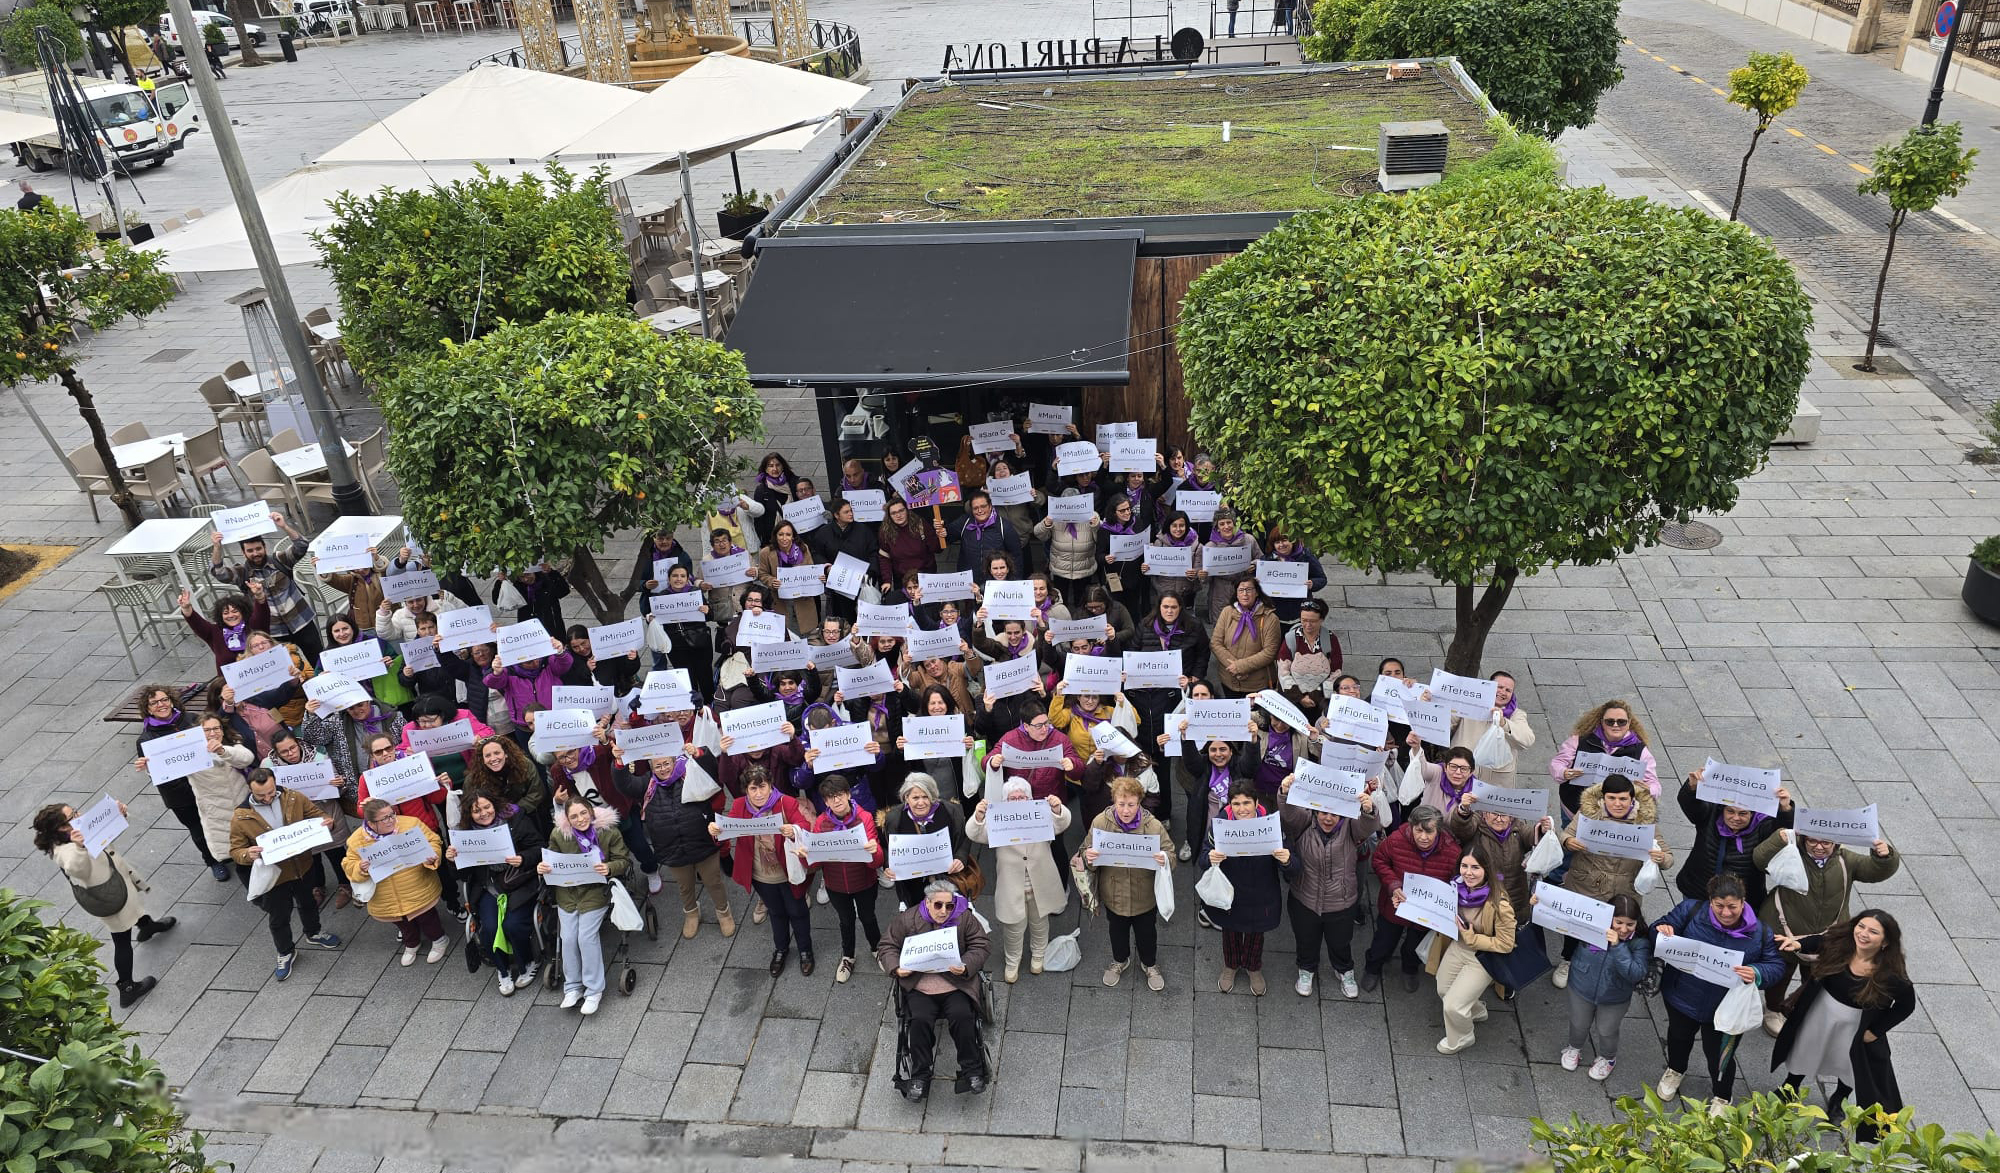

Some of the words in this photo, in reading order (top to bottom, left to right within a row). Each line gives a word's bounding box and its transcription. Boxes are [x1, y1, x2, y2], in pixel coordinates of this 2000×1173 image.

[979, 429, 999, 438] #Sara
[1062, 449, 1093, 457] #Matilde
[992, 483, 1027, 493] #Carolina
[1055, 502, 1087, 510] #Marisol
[225, 511, 260, 524] #Nacho
[326, 542, 349, 552] #Ana
[1123, 539, 1143, 548] #Pilar
[1267, 571, 1298, 579] #Gema
[392, 576, 428, 589] #Beatriz
[928, 580, 965, 589] #Virginia
[994, 591, 1024, 599] #Nuria
[655, 601, 675, 610] #Eva
[449, 617, 478, 629] #Elisa
[749, 622, 771, 630] #Sara
[500, 628, 544, 645] #Carmen
[600, 628, 635, 641] #Miriam
[914, 637, 953, 646] #Cristina
[757, 648, 801, 657] #Yolanda
[333, 651, 370, 666] #Noelia
[238, 659, 276, 679] #Mayca
[995, 665, 1031, 680] #Beatriz
[1076, 666, 1108, 675] #Laura
[851, 675, 875, 683] #Bea
[316, 678, 350, 695] #Lucila
[648, 681, 677, 690] #Rosa
[1440, 684, 1482, 699] #Teresa
[558, 694, 609, 704] #Madalina
[1194, 710, 1241, 719] #Victoria
[1338, 706, 1379, 723] #Fiorella
[546, 719, 589, 730] #Cecilia
[727, 715, 782, 732] #Montserrat
[918, 727, 949, 735] #Juani
[433, 730, 469, 744] Victoria
[825, 736, 859, 748] #Isidro
[165, 751, 196, 765] #Rosa
[1579, 761, 1640, 777] #Esmeralda
[281, 771, 325, 784] #Patricia
[375, 764, 424, 786] #Soledad
[1300, 772, 1357, 794] #Verónica
[1712, 772, 1767, 791] #Jessica
[1487, 794, 1532, 805] #Josefa
[994, 812, 1032, 822] #Isabel
[722, 822, 776, 830] #Manuela
[1809, 818, 1867, 830] #Blanca
[272, 824, 313, 844] #Rafael
[1224, 829, 1254, 838] #Alba
[1590, 828, 1640, 843] #Manoli
[461, 838, 487, 846] #Ana
[811, 837, 859, 847] #Cristina
[1100, 842, 1152, 852] #Catalina
[367, 836, 421, 862] #Mercedes
[912, 842, 948, 855] Dolores
[552, 861, 589, 869] #Bruna
[1551, 899, 1592, 922] #Laura
[904, 941, 954, 956] #Francisca
[1665, 949, 1709, 962] #Isabel
